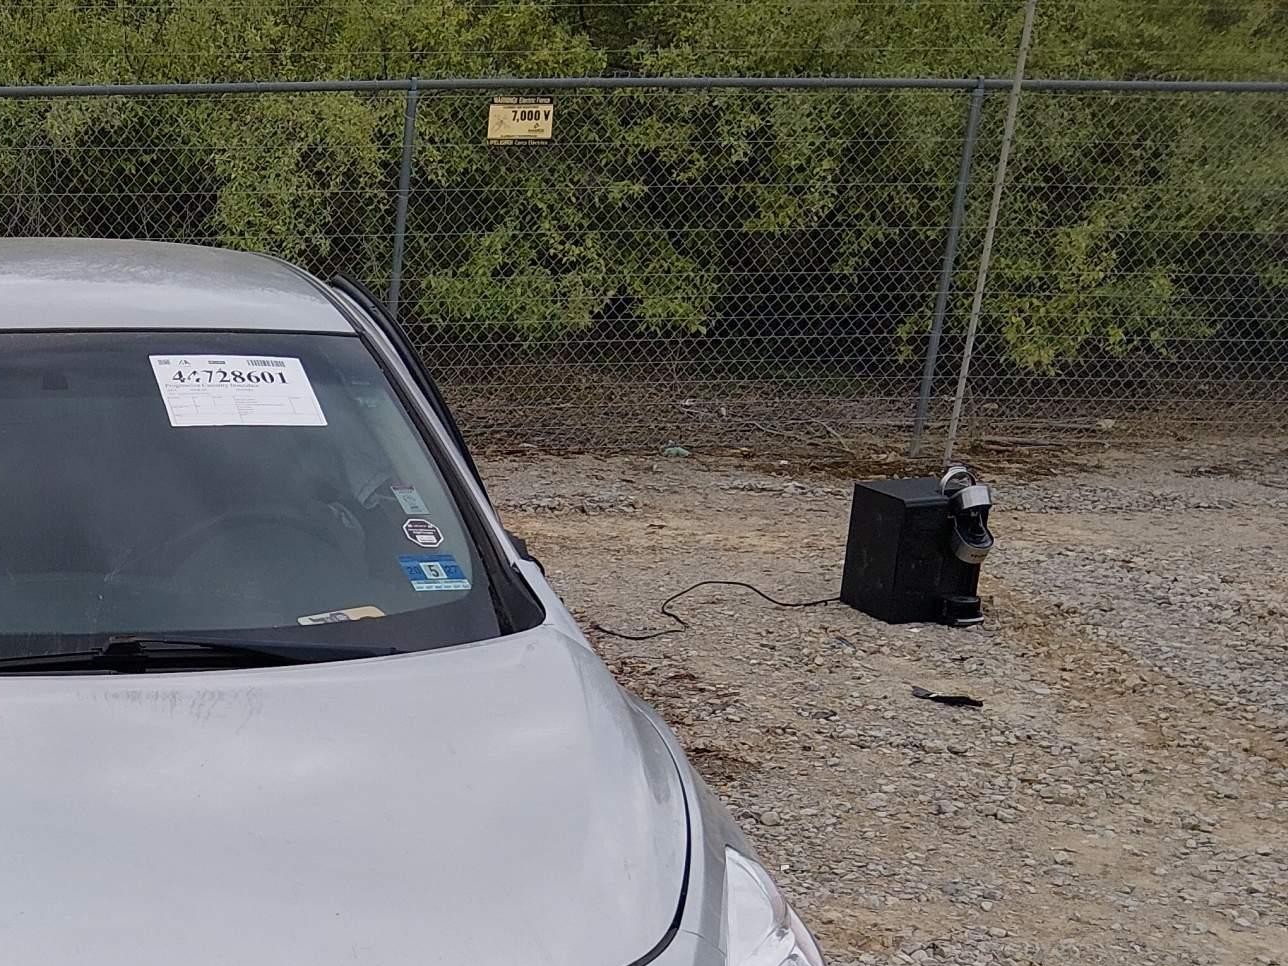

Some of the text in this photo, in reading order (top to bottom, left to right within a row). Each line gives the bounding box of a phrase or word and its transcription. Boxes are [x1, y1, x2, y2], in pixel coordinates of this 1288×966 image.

[511, 110, 551, 122] 7,000 V
[427, 564, 440, 578] 5
